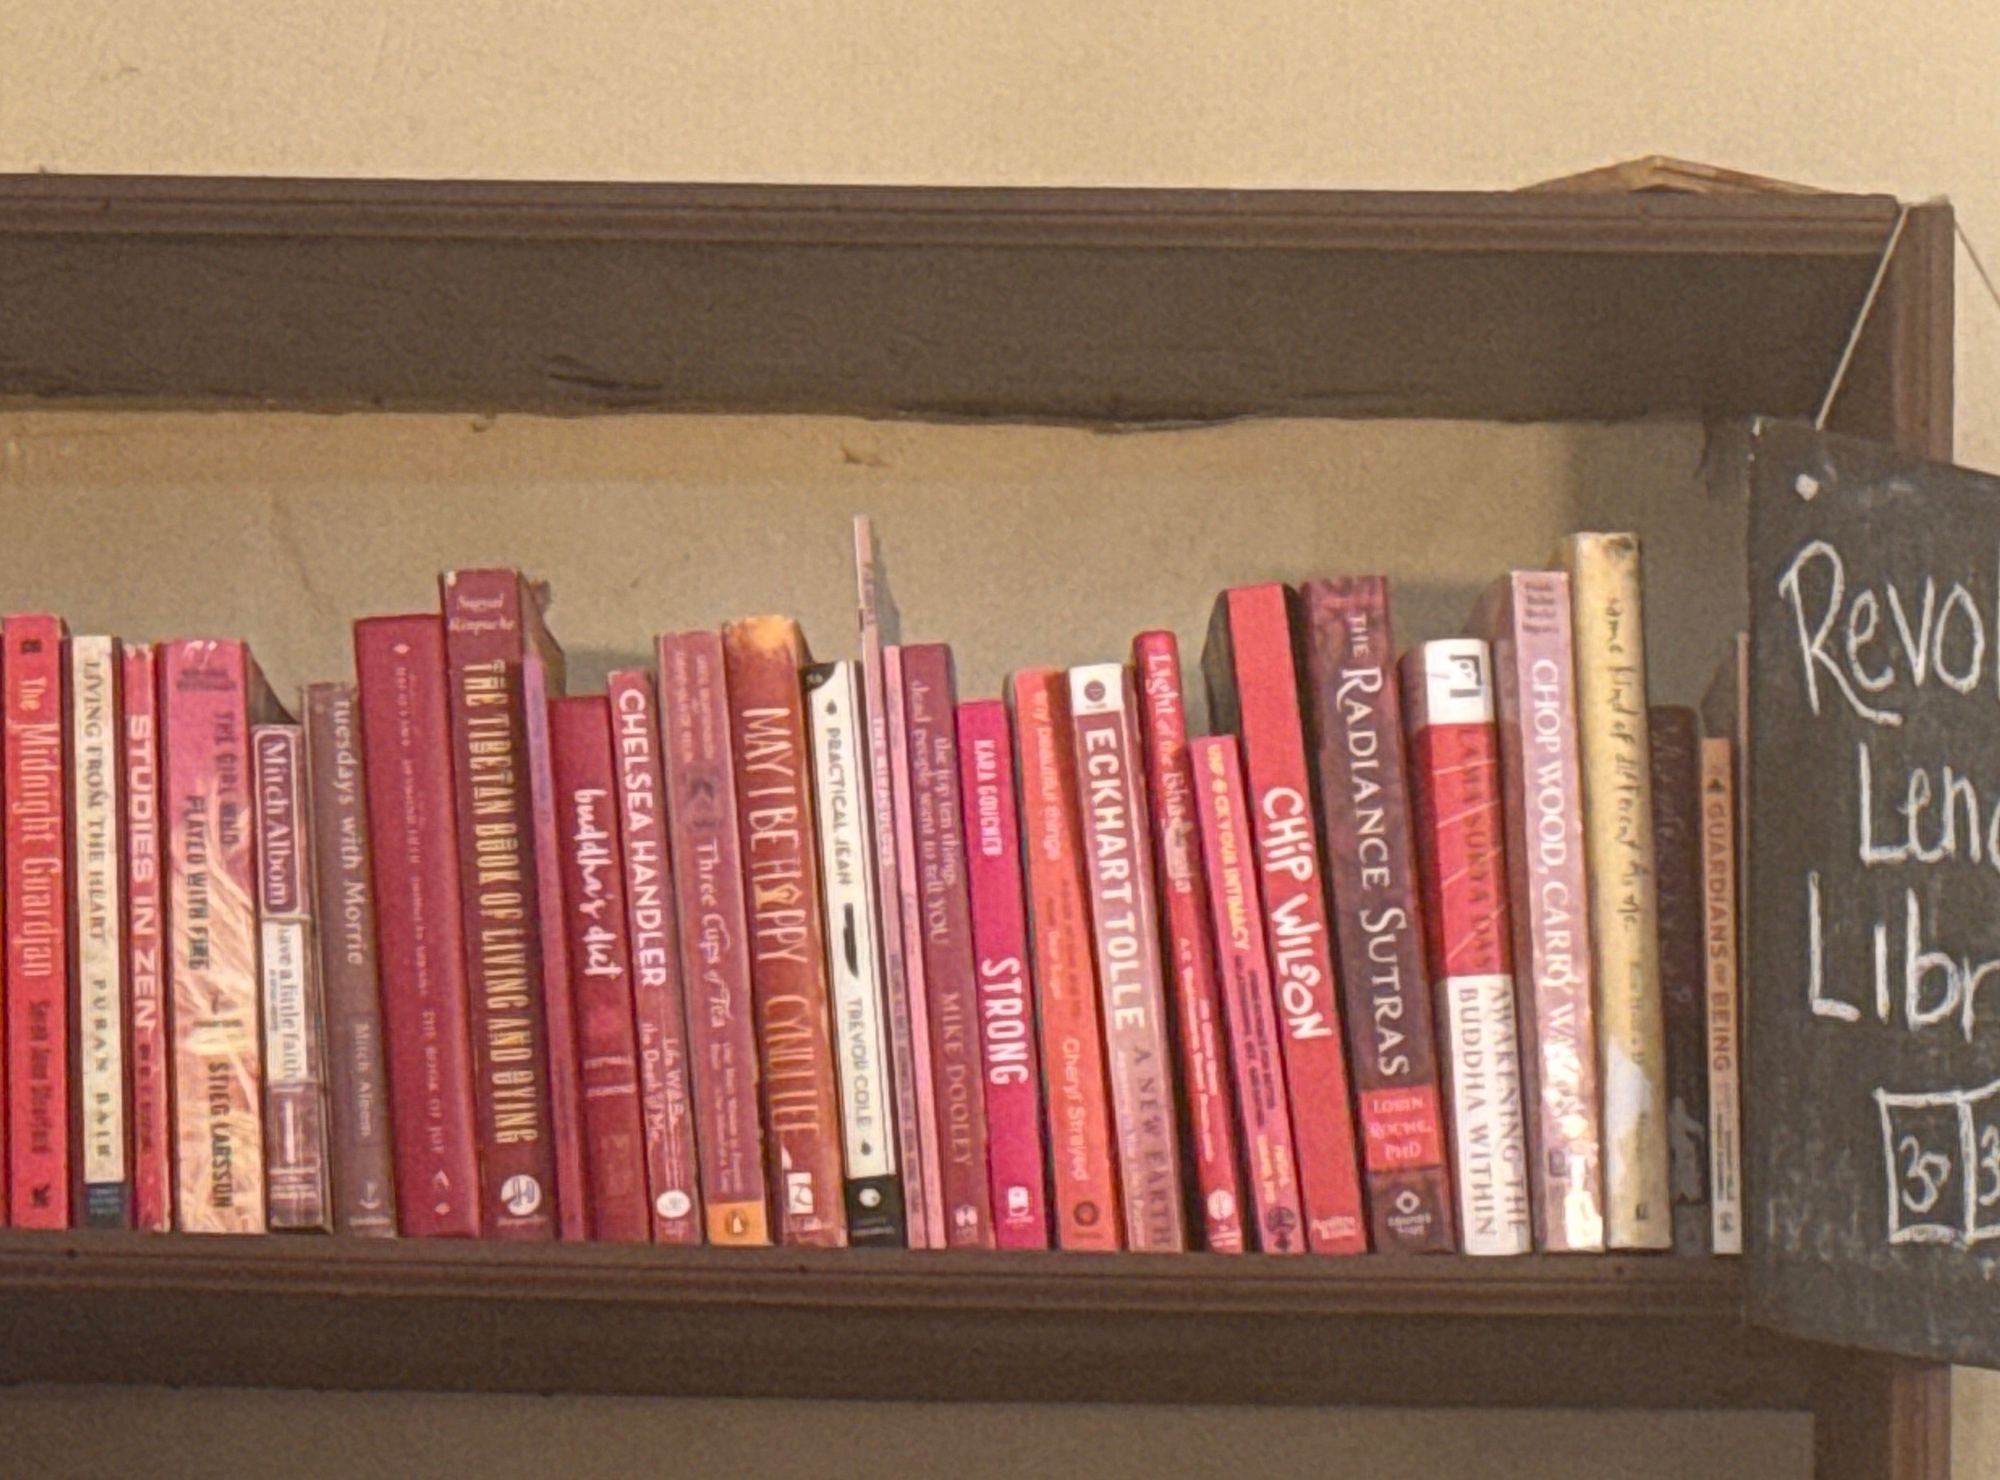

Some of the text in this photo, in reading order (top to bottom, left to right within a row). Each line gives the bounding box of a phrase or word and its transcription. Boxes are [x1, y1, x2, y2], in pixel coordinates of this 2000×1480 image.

[1145, 653, 1179, 715] Light
[1778, 540, 2000, 726] Revo
[17, 677, 47, 712] The
[741, 706, 796, 777] MAY
[1531, 659, 1562, 751] CHOP
[7, 719, 61, 843] Midnight
[84, 661, 108, 938] LIVING FROM THE HEART
[127, 714, 155, 883] STUDIES
[826, 727, 853, 886] PRACTICAL JEAN
[973, 739, 998, 783] KARA
[1085, 727, 1133, 905] ECKHART
[1535, 760, 1568, 875] WOOD,
[262, 741, 292, 905] Mitch Albom
[340, 816, 363, 870] with
[618, 688, 667, 987] CHELSEA HANDLER
[697, 836, 720, 907] Three
[748, 805, 800, 853] BE
[1336, 613, 1409, 1076] THE RADIANCE SUTRAS
[19, 857, 62, 977] Guardian
[130, 895, 156, 936] IN
[343, 881, 369, 965] Morrie
[463, 659, 539, 1144] THE TIBETAN BOOK OF LIVING AND DYING
[928, 898, 950, 945] YOU
[1539, 881, 1581, 994] CARRY
[1706, 803, 1733, 960] GUARDIANS
[131, 950, 157, 1031] ZEN
[699, 913, 731, 965] Cups
[1104, 911, 1146, 1032] TOLLE
[1271, 893, 1332, 1041] WILSON
[981, 957, 1029, 1085] STRONG
[1711, 991, 1734, 1072] BEING
[853, 1073, 872, 1129] COLE
[940, 992, 973, 1165] MIKE DOOLEY
[1459, 987, 1497, 1237] BUDDHA WITHIN
[1147, 1156, 1171, 1246] EARTH
[1504, 1178, 1528, 1228] THE
